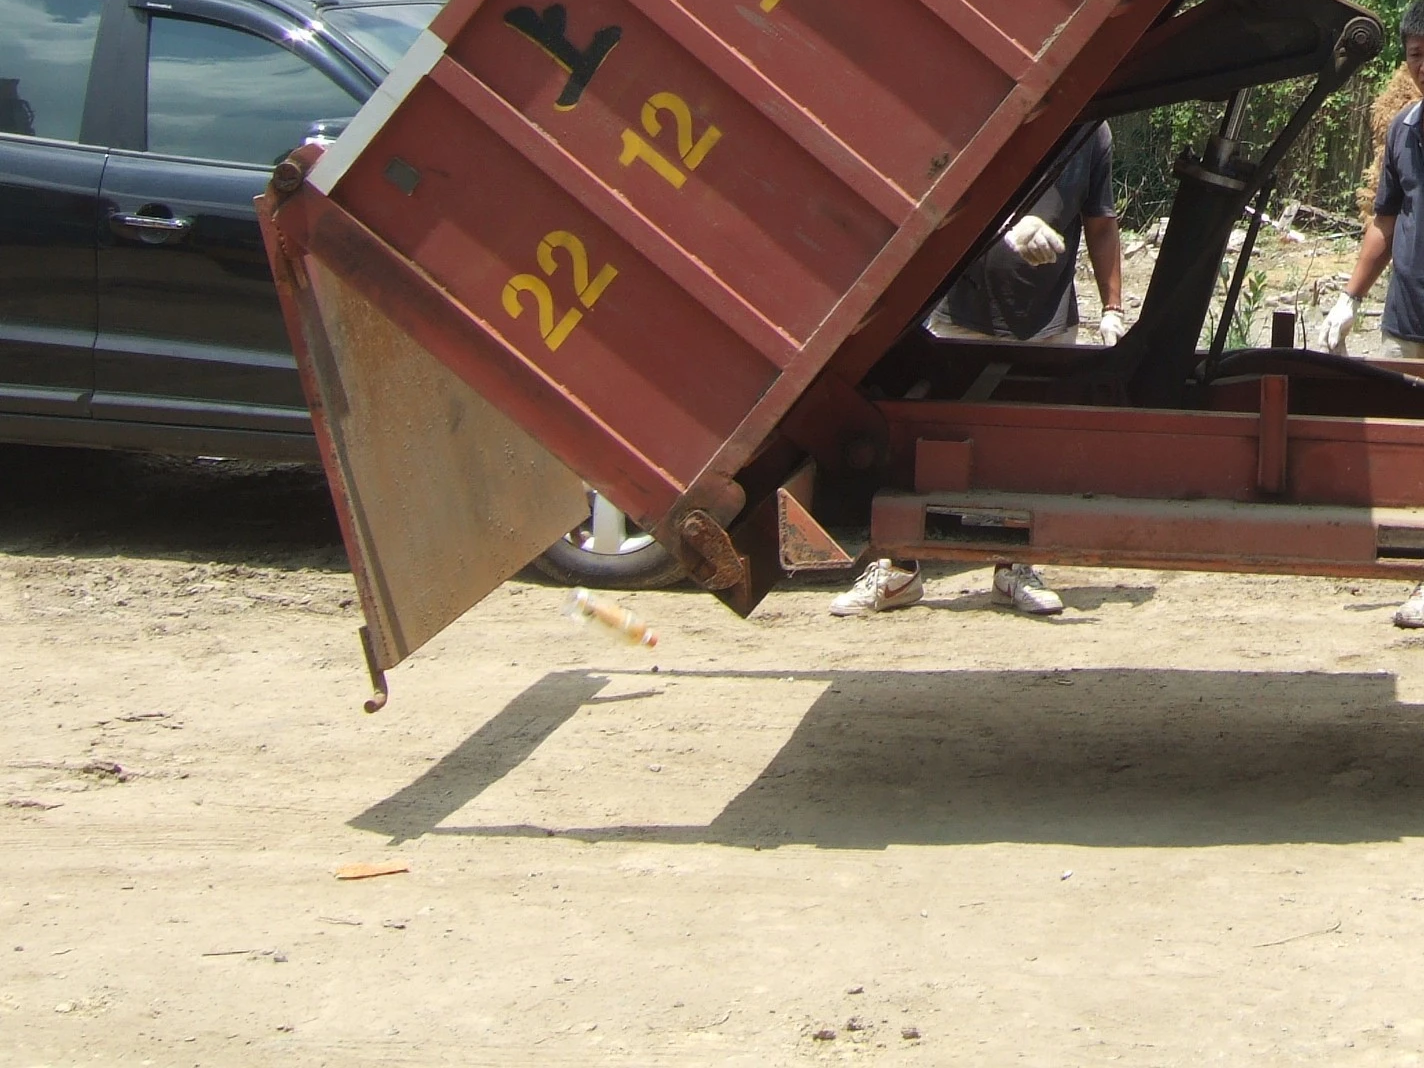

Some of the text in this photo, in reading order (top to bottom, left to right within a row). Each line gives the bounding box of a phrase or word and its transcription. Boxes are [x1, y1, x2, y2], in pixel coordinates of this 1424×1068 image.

[502, 1, 622, 111] 上
[502, 230, 619, 352] 22
[618, 91, 723, 190] 12
